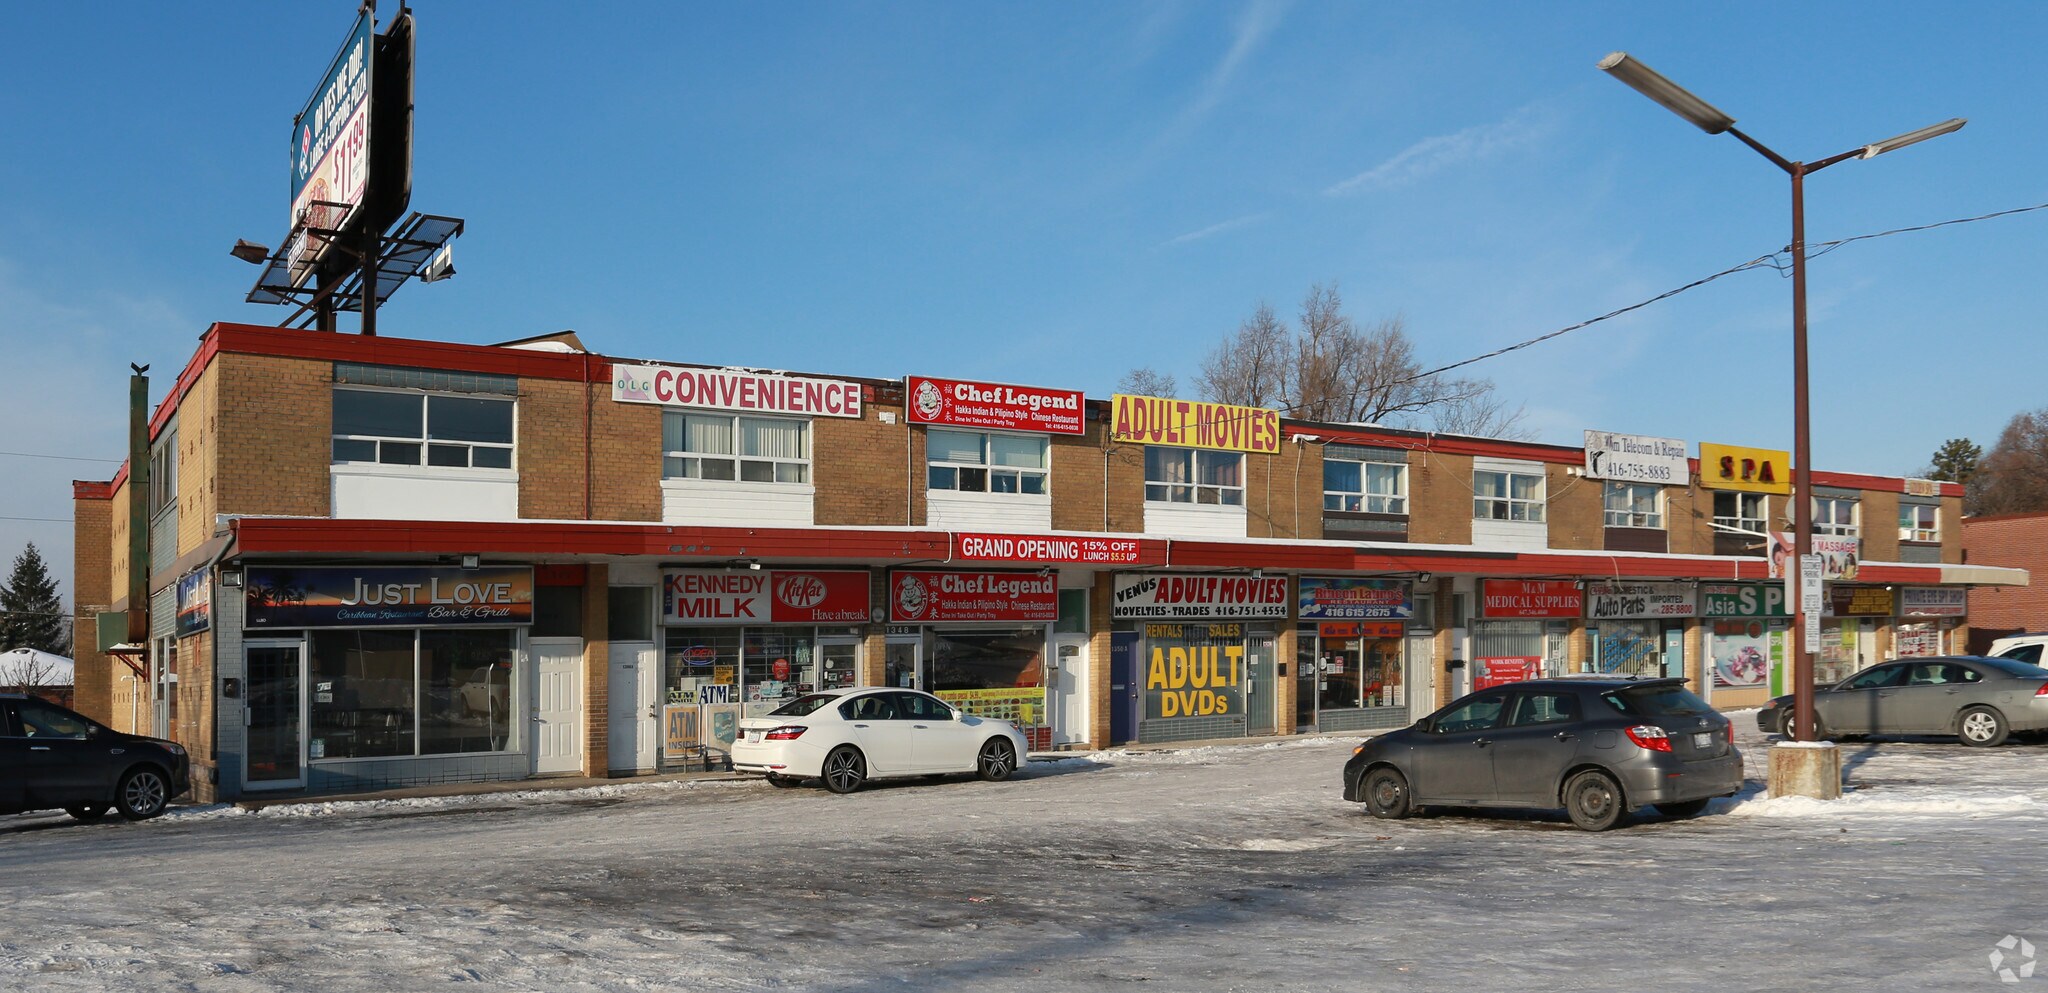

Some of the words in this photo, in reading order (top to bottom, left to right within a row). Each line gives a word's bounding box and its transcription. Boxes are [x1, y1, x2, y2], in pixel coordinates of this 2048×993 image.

[314, 101, 324, 138] OH
[324, 82, 336, 123] YES
[336, 62, 348, 104] WE
[348, 37, 363, 87] DID!
[310, 136, 325, 173] LARGE
[350, 67, 367, 108] PIZZA
[655, 370, 858, 415] CONVENIENCE
[954, 383, 1002, 404] Chef
[1005, 388, 1078, 411] Legend
[955, 405, 972, 415] Hakka
[972, 406, 989, 416] Indian
[990, 408, 994, 417] &
[994, 409, 1014, 420] Pilipino
[1015, 410, 1028, 421] Style
[1031, 411, 1051, 422] Chinese
[1052, 413, 1079, 424] Restaurant
[994, 419, 1004, 427] Party
[1116, 396, 1190, 443] ADULT
[1196, 404, 1277, 451] MOVIES
[1622, 437, 1653, 455] Telecom
[1654, 441, 1660, 456] &
[1661, 442, 1684, 460] Repair
[1608, 461, 1671, 480] 416-755-8883
[1719, 455, 1775, 482] SPA
[962, 537, 1014, 558] GRAND
[1016, 538, 1079, 560] OPENING
[1082, 540, 1108, 551] 15%
[1111, 541, 1136, 551] OFF
[1818, 541, 1856, 553] MASSAGE
[1083, 551, 1109, 561] LUNCH
[1110, 552, 1126, 561] $5.5
[1126, 553, 1137, 562] UP
[671, 574, 766, 594] KENNEDY
[916, 581, 927, 596] Chef
[941, 575, 984, 594] Chef
[987, 575, 1054, 599] Legend
[1116, 577, 1157, 603] VENUS
[1154, 577, 1218, 604] ADULT
[1219, 578, 1287, 604] MOVIES
[1614, 586, 1648, 594] DOMESTIC
[1649, 586, 1654, 594] &
[677, 597, 756, 618] MILK
[912, 597, 927, 618] Legend
[941, 600, 957, 609] Hakka
[957, 600, 972, 610] Indian
[972, 601, 977, 609] &
[978, 600, 996, 611] Pilipino
[996, 600, 1008, 611] Style
[1011, 601, 1029, 610] Chinese
[1029, 601, 1055, 610] Restaurant
[1486, 595, 1533, 608] MEDICAL
[1535, 595, 1580, 608] SUPPLIES
[1594, 596, 1619, 617] Auto
[1620, 595, 1646, 616] Parts
[1650, 595, 1684, 604] IMPORTED
[1706, 596, 1736, 615] Asia
[1739, 586, 1782, 615] SP
[337, 609, 377, 621] Caribbean
[379, 609, 425, 620] Restaurant
[427, 605, 457, 619] Bar
[459, 605, 474, 619] &
[474, 605, 510, 619] Grill
[812, 609, 834, 620] Have
[835, 612, 841, 620] a
[841, 609, 868, 620] break.
[1172, 606, 1210, 616] TRADES
[1215, 606, 1287, 615] 416-751-4554
[1325, 608, 1344, 617] 416
[1345, 608, 1365, 617] 615
[1366, 608, 1391, 617] 2675
[1661, 604, 1693, 614] 285-8800
[886, 626, 909, 634] 1348
[1146, 624, 1183, 638] RENTALS
[1208, 624, 1240, 637] SALES
[685, 648, 715, 657] OPEN
[1147, 645, 1243, 690] ADULT
[698, 685, 727, 704] ATM
[1161, 690, 1229, 718] DVDs
[669, 711, 696, 739] ATM
[668, 741, 697, 750] INSIDE
